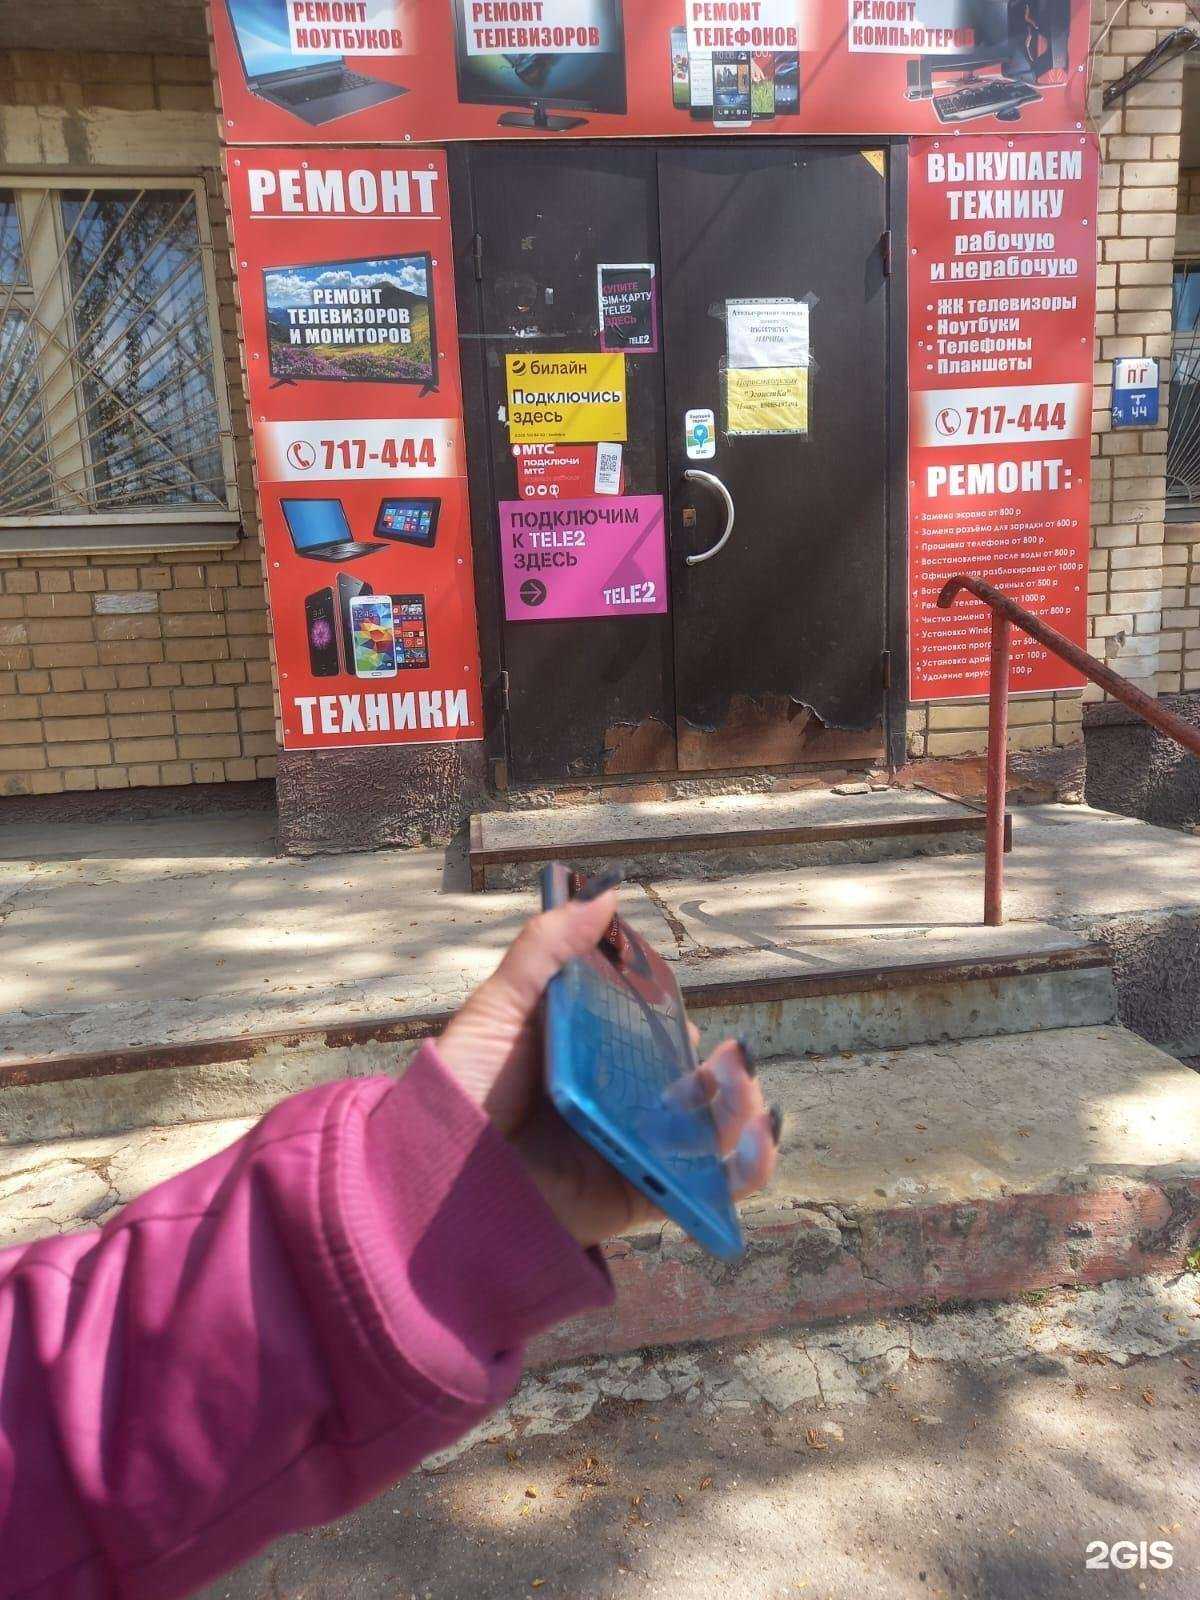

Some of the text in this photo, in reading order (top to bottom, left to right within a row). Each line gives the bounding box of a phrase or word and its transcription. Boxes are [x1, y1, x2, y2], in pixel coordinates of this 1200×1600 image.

[294, 2, 367, 22] РЕМОНТ
[472, 2, 543, 22] РЕМОНТ
[693, 2, 761, 21] РЕМОНТ
[853, 1, 916, 21] РЕМОНТ
[296, 28, 403, 49] НОУТБУКОВ
[473, 27, 600, 48] ТЕЛЕВИЗОРОВ
[694, 27, 797, 46] ТЕЛЕФОНОВ
[853, 26, 975, 48] КОМПЬЮТЕРОВ
[927, 150, 1083, 183] ВЫКУПАЕМ
[247, 169, 438, 214] РЕМОНТ
[946, 189, 1064, 220] ТЕХНИКУ
[955, 230, 1055, 255] рабочую
[930, 256, 1078, 280] и нерабочую
[313, 288, 382, 305] РЕМОНТ
[937, 296, 1077, 315] ЖК телевизоры
[287, 308, 410, 324] ТЕЛЕВИЗОРОВ
[603, 305, 631, 316] TELE2
[937, 317, 1020, 335] Ноутбуки
[290, 328, 411, 344] И МОНИТОРОВ
[629, 335, 650, 344] TELE2
[937, 336, 1032, 355] Телефоны
[530, 360, 587, 375] билайн
[937, 357, 1032, 374] Планшеты
[1127, 368, 1148, 384] ПГ
[512, 388, 620, 406] Подключись
[513, 411, 563, 425] здесь
[966, 403, 1066, 434] 717-444
[320, 438, 437, 470] 717-444
[522, 443, 554, 455] МТС
[927, 459, 1072, 498] РЕМОНТ:
[511, 508, 639, 530] ПОДКЛЮЧИМ
[921, 512, 954, 521] Замена
[921, 527, 954, 536] Замена
[1010, 522, 1043, 532] зарядки
[512, 530, 586, 548] К TELE2
[921, 542, 965, 552] Прошивка
[966, 540, 1010, 548] телефона
[514, 551, 578, 571] ЗДЕСЬ
[921, 555, 992, 566] Восстановление
[993, 552, 1019, 561] после
[1020, 552, 1042, 560] воды
[1070, 549, 1076, 557] р
[983, 566, 1046, 577] разблокировка
[1058, 562, 1077, 571] 1000
[1078, 562, 1084, 571] р
[603, 581, 656, 605] TELE2
[921, 616, 951, 624] Чистка
[953, 613, 985, 622] замена
[1065, 607, 1071, 616] р
[921, 630, 967, 639] Установка
[922, 644, 967, 653] Установка
[922, 659, 967, 668] Установка
[1026, 651, 1040, 659] 100
[1041, 652, 1047, 660] р
[922, 672, 963, 682] Удаление
[294, 689, 469, 734] ТЕХНИКИ
